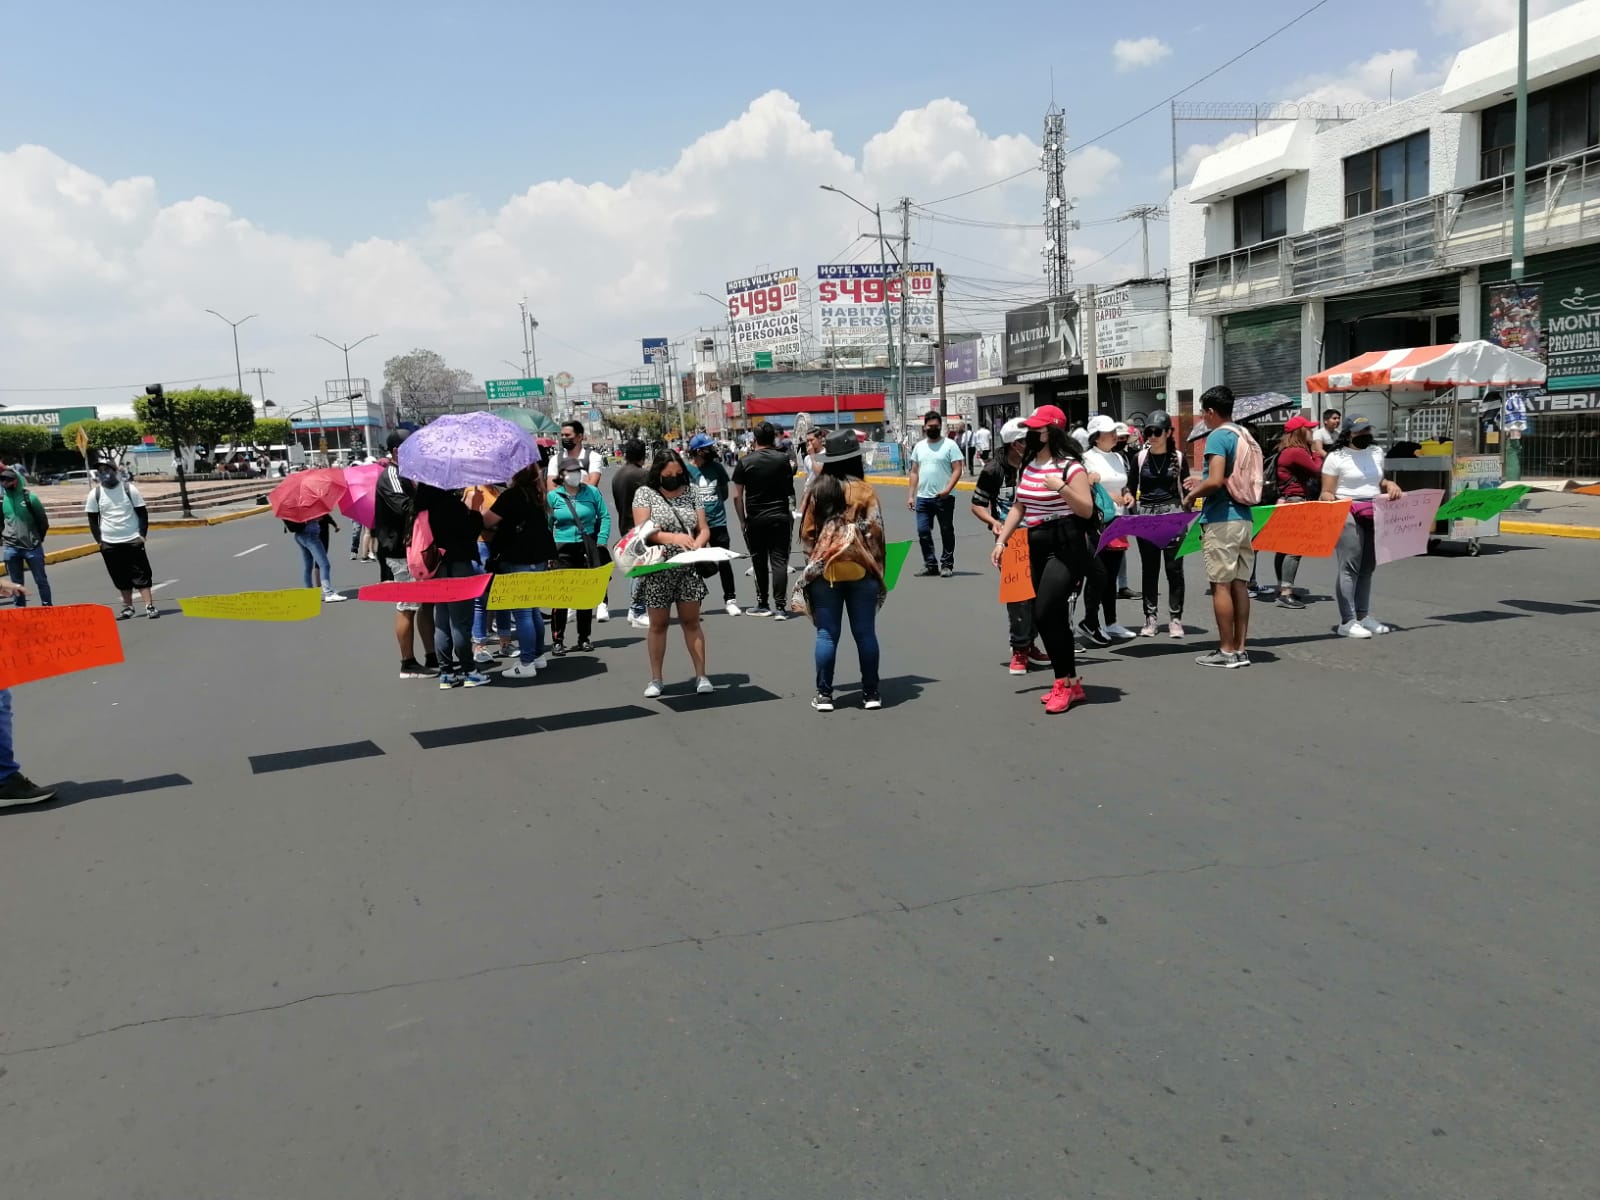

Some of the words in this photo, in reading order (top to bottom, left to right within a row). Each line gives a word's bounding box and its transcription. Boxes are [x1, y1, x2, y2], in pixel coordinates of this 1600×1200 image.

[821, 264, 858, 274] HOTEL
[861, 263, 894, 274] VILLA
[728, 279, 750, 290] HOTEL
[751, 274, 773, 286] VILLA
[773, 268, 796, 280] CAPRI
[821, 318, 832, 327] 2
[739, 324, 799, 342] PERSONAS
[1020, 325, 1050, 343] NUTRIA
